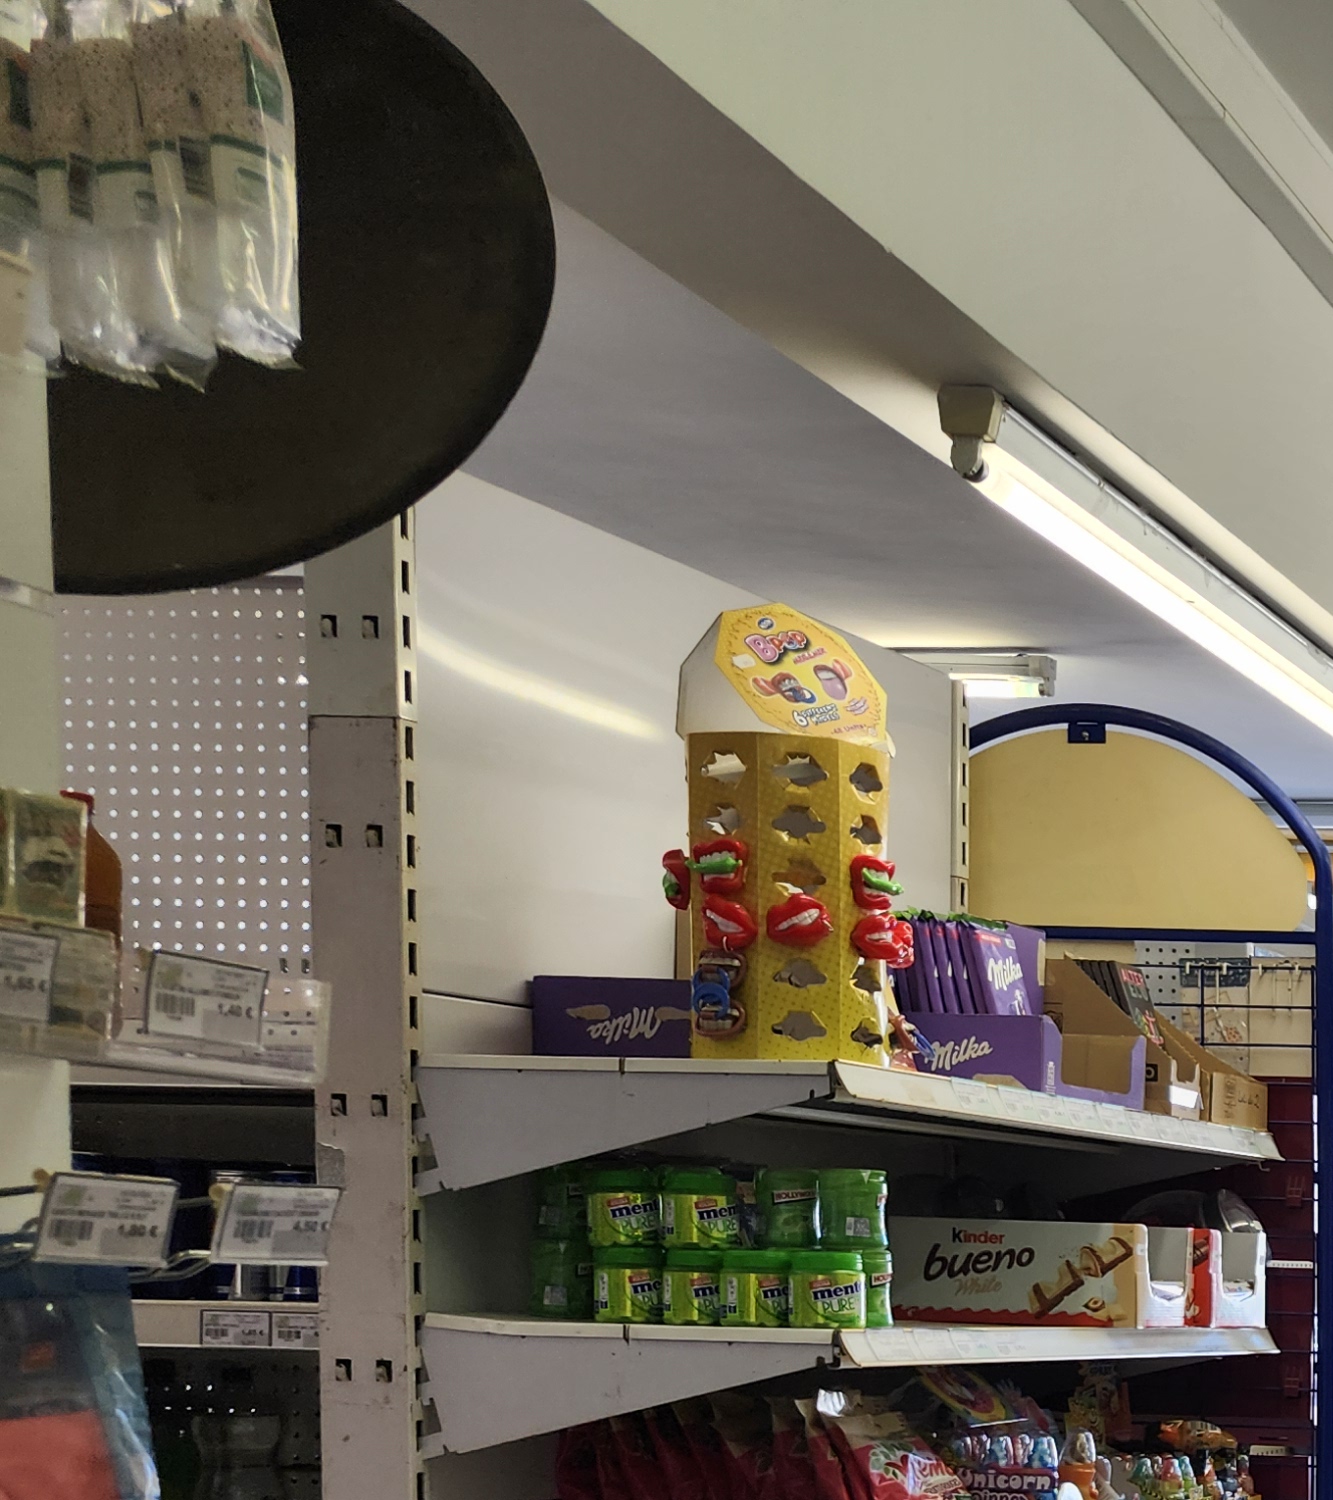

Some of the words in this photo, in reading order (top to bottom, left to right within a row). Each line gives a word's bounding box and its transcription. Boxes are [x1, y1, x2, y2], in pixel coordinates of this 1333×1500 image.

[792, 709, 809, 728] 6
[987, 958, 1024, 990] Milka
[587, 1004, 660, 1041] Milka
[925, 1035, 993, 1072] Milka
[621, 1217, 655, 1230] PURE
[952, 1227, 1005, 1245] Kinder
[923, 1243, 1035, 1281] bueno
[821, 1298, 856, 1313] PURE
[957, 1467, 1051, 1491] Unicorn
